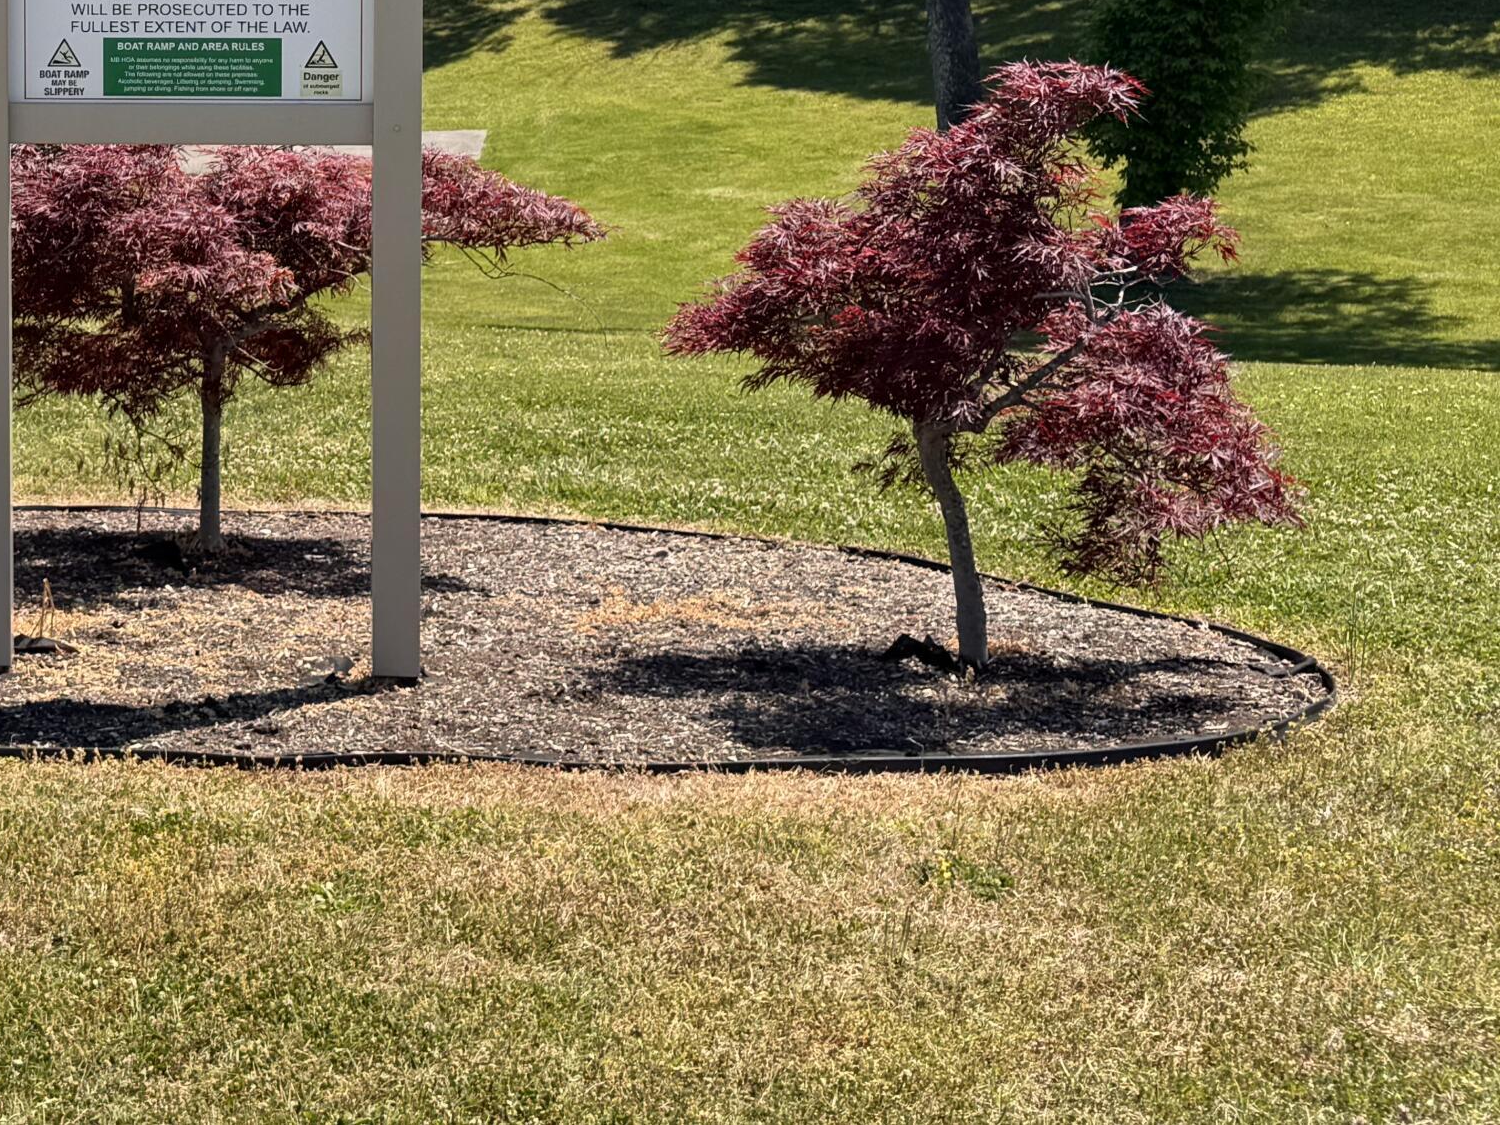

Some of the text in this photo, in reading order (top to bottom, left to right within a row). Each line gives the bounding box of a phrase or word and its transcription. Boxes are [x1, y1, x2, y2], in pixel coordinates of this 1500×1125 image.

[72, 3, 309, 16] WILL BE PROSECUTED TO THE
[71, 21, 311, 33] FULLEST EXTENT OF THE LAW.
[117, 42, 265, 51] BOAT RAMP AND AREA RULES
[39, 69, 90, 79] BOAT RAMP
[303, 72, 339, 83] Danger
[44, 87, 84, 96] SLIPPERY
